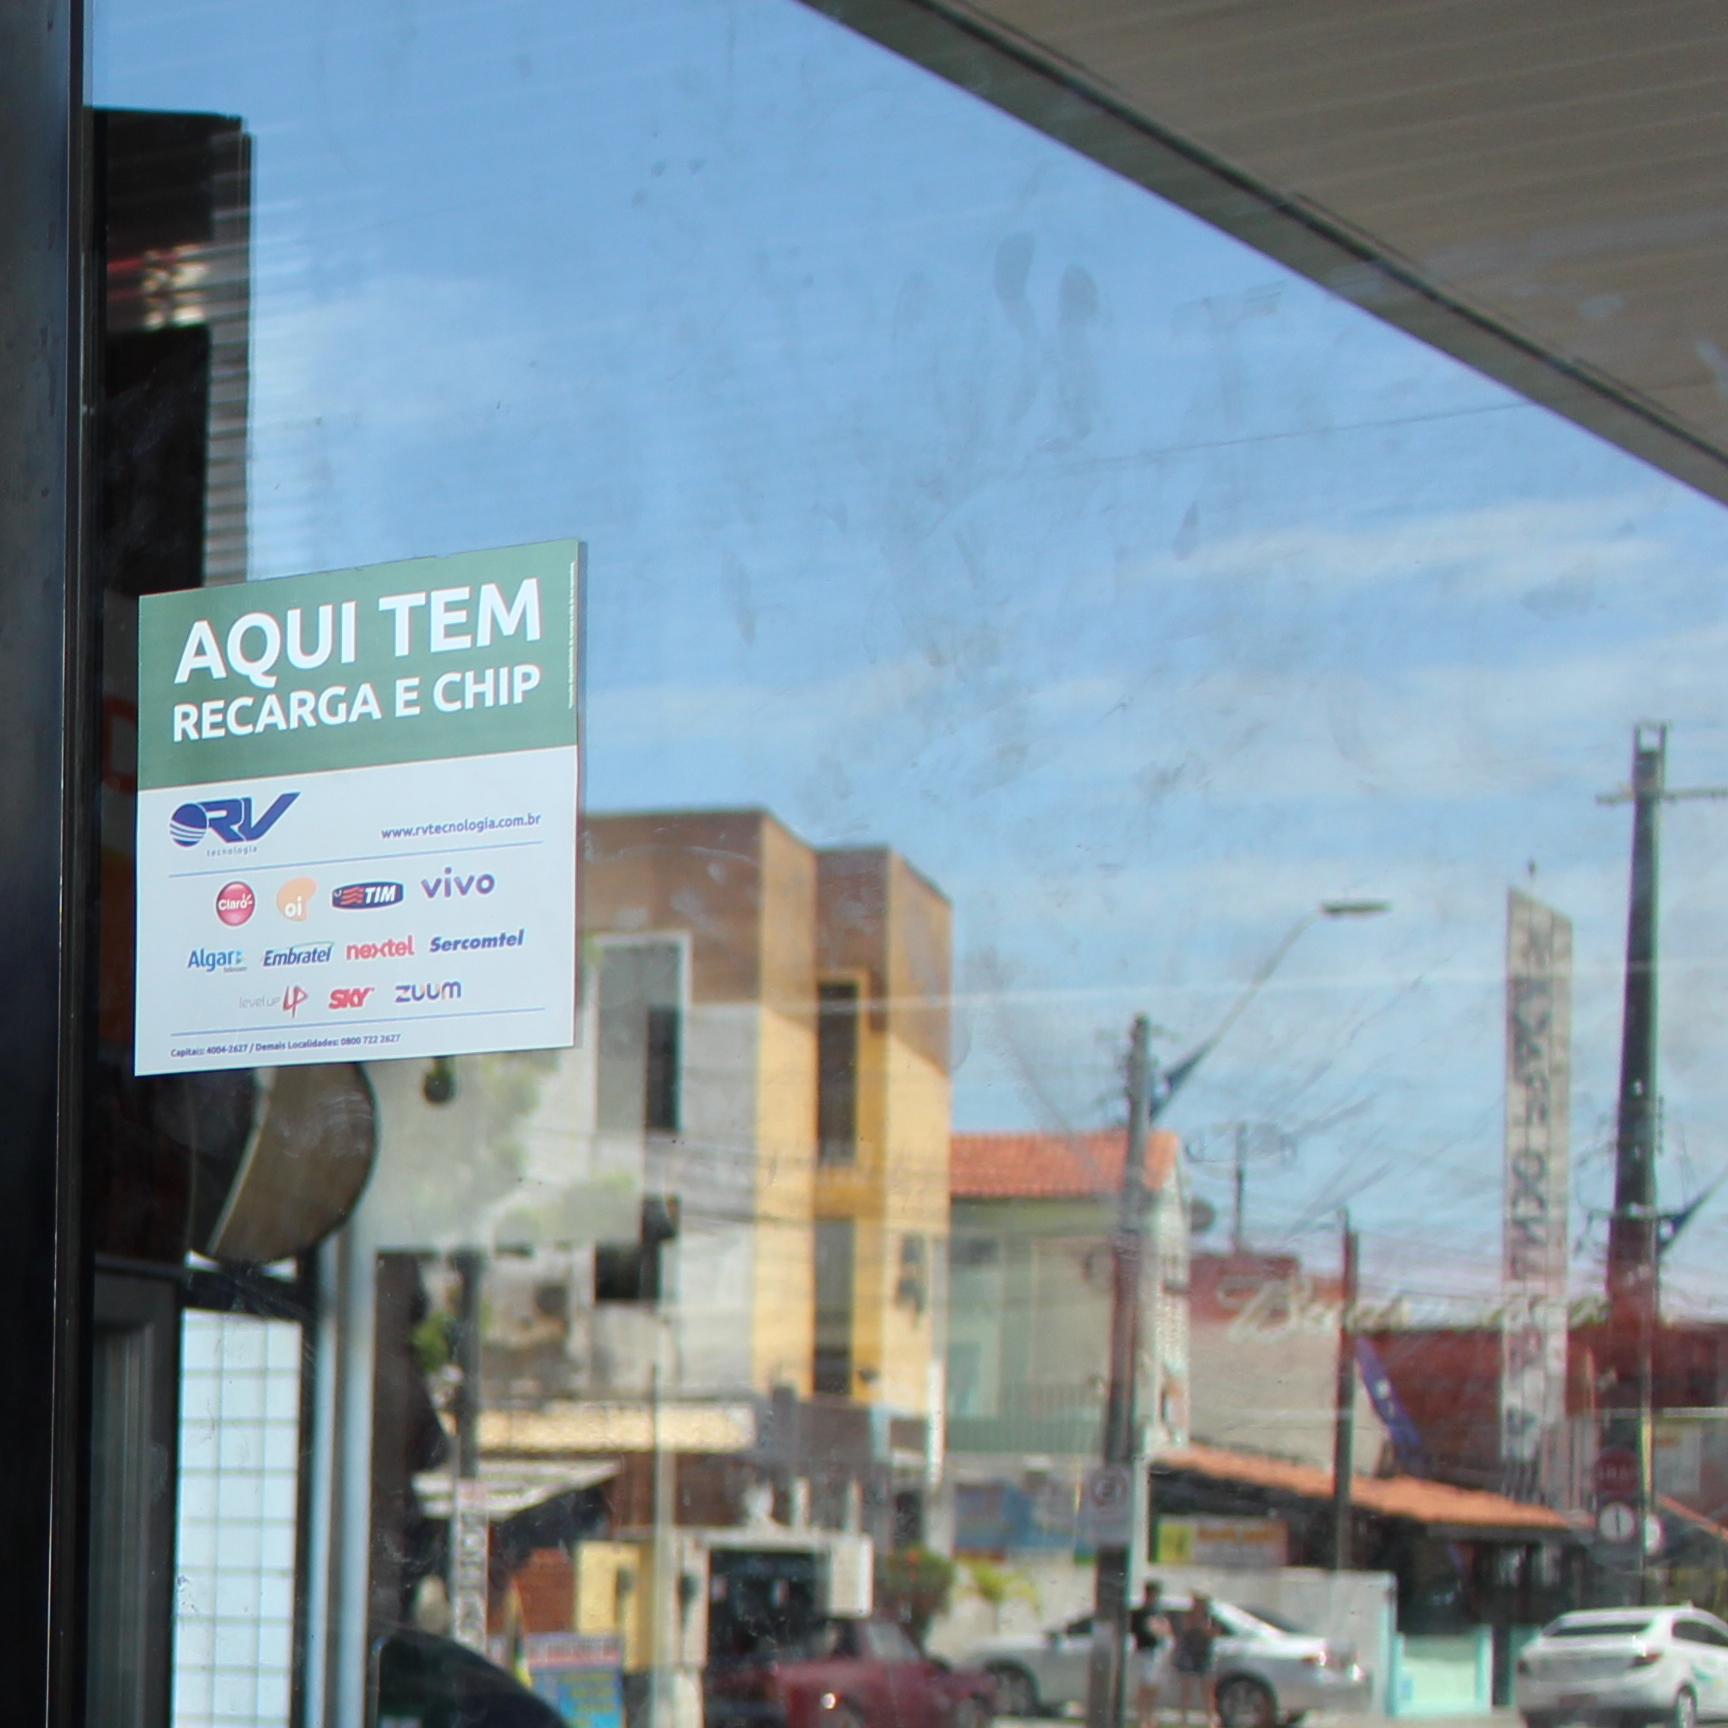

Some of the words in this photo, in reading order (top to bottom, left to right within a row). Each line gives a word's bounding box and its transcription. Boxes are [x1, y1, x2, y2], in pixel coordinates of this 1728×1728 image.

[174, 601, 357, 688] AQUI
[378, 577, 542, 657] TEM
[173, 682, 381, 742] RECARGA
[394, 677, 421, 717] E
[432, 663, 541, 712] CHIP
[380, 813, 542, 841] www.rvtecnologia.com.br
[364, 884, 397, 904] TIM
[420, 866, 496, 899] vivo
[346, 936, 415, 961] nextel
[429, 929, 525, 953] Sercomtel
[187, 947, 235, 973] Algar
[263, 945, 332, 968] Embratel
[328, 987, 370, 1010] SKY
[255, 1041, 286, 1053] Demais
